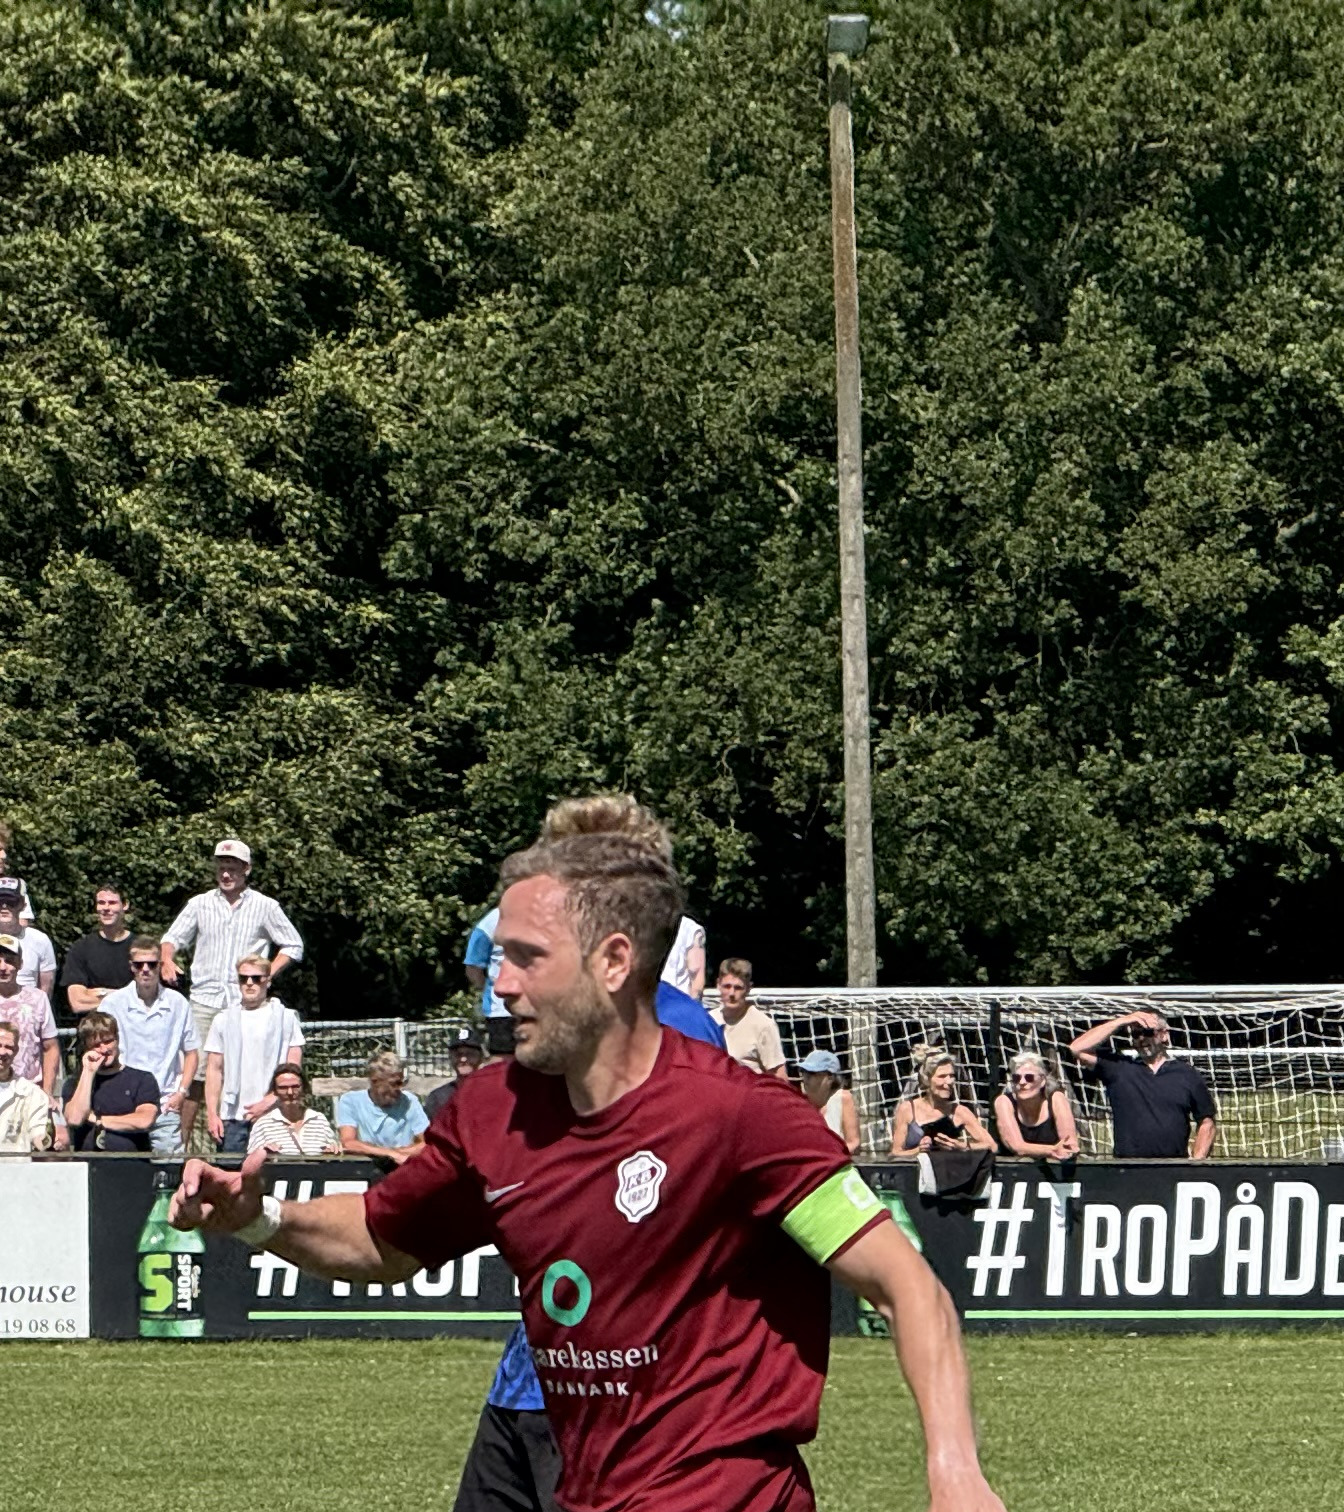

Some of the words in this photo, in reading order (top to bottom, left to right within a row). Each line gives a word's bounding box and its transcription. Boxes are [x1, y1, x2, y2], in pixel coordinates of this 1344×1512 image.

[177, 1254, 192, 1312] SPORT
[4, 1319, 23, 1334] 19
[28, 1319, 49, 1334] 08
[55, 1319, 76, 1334] 68
